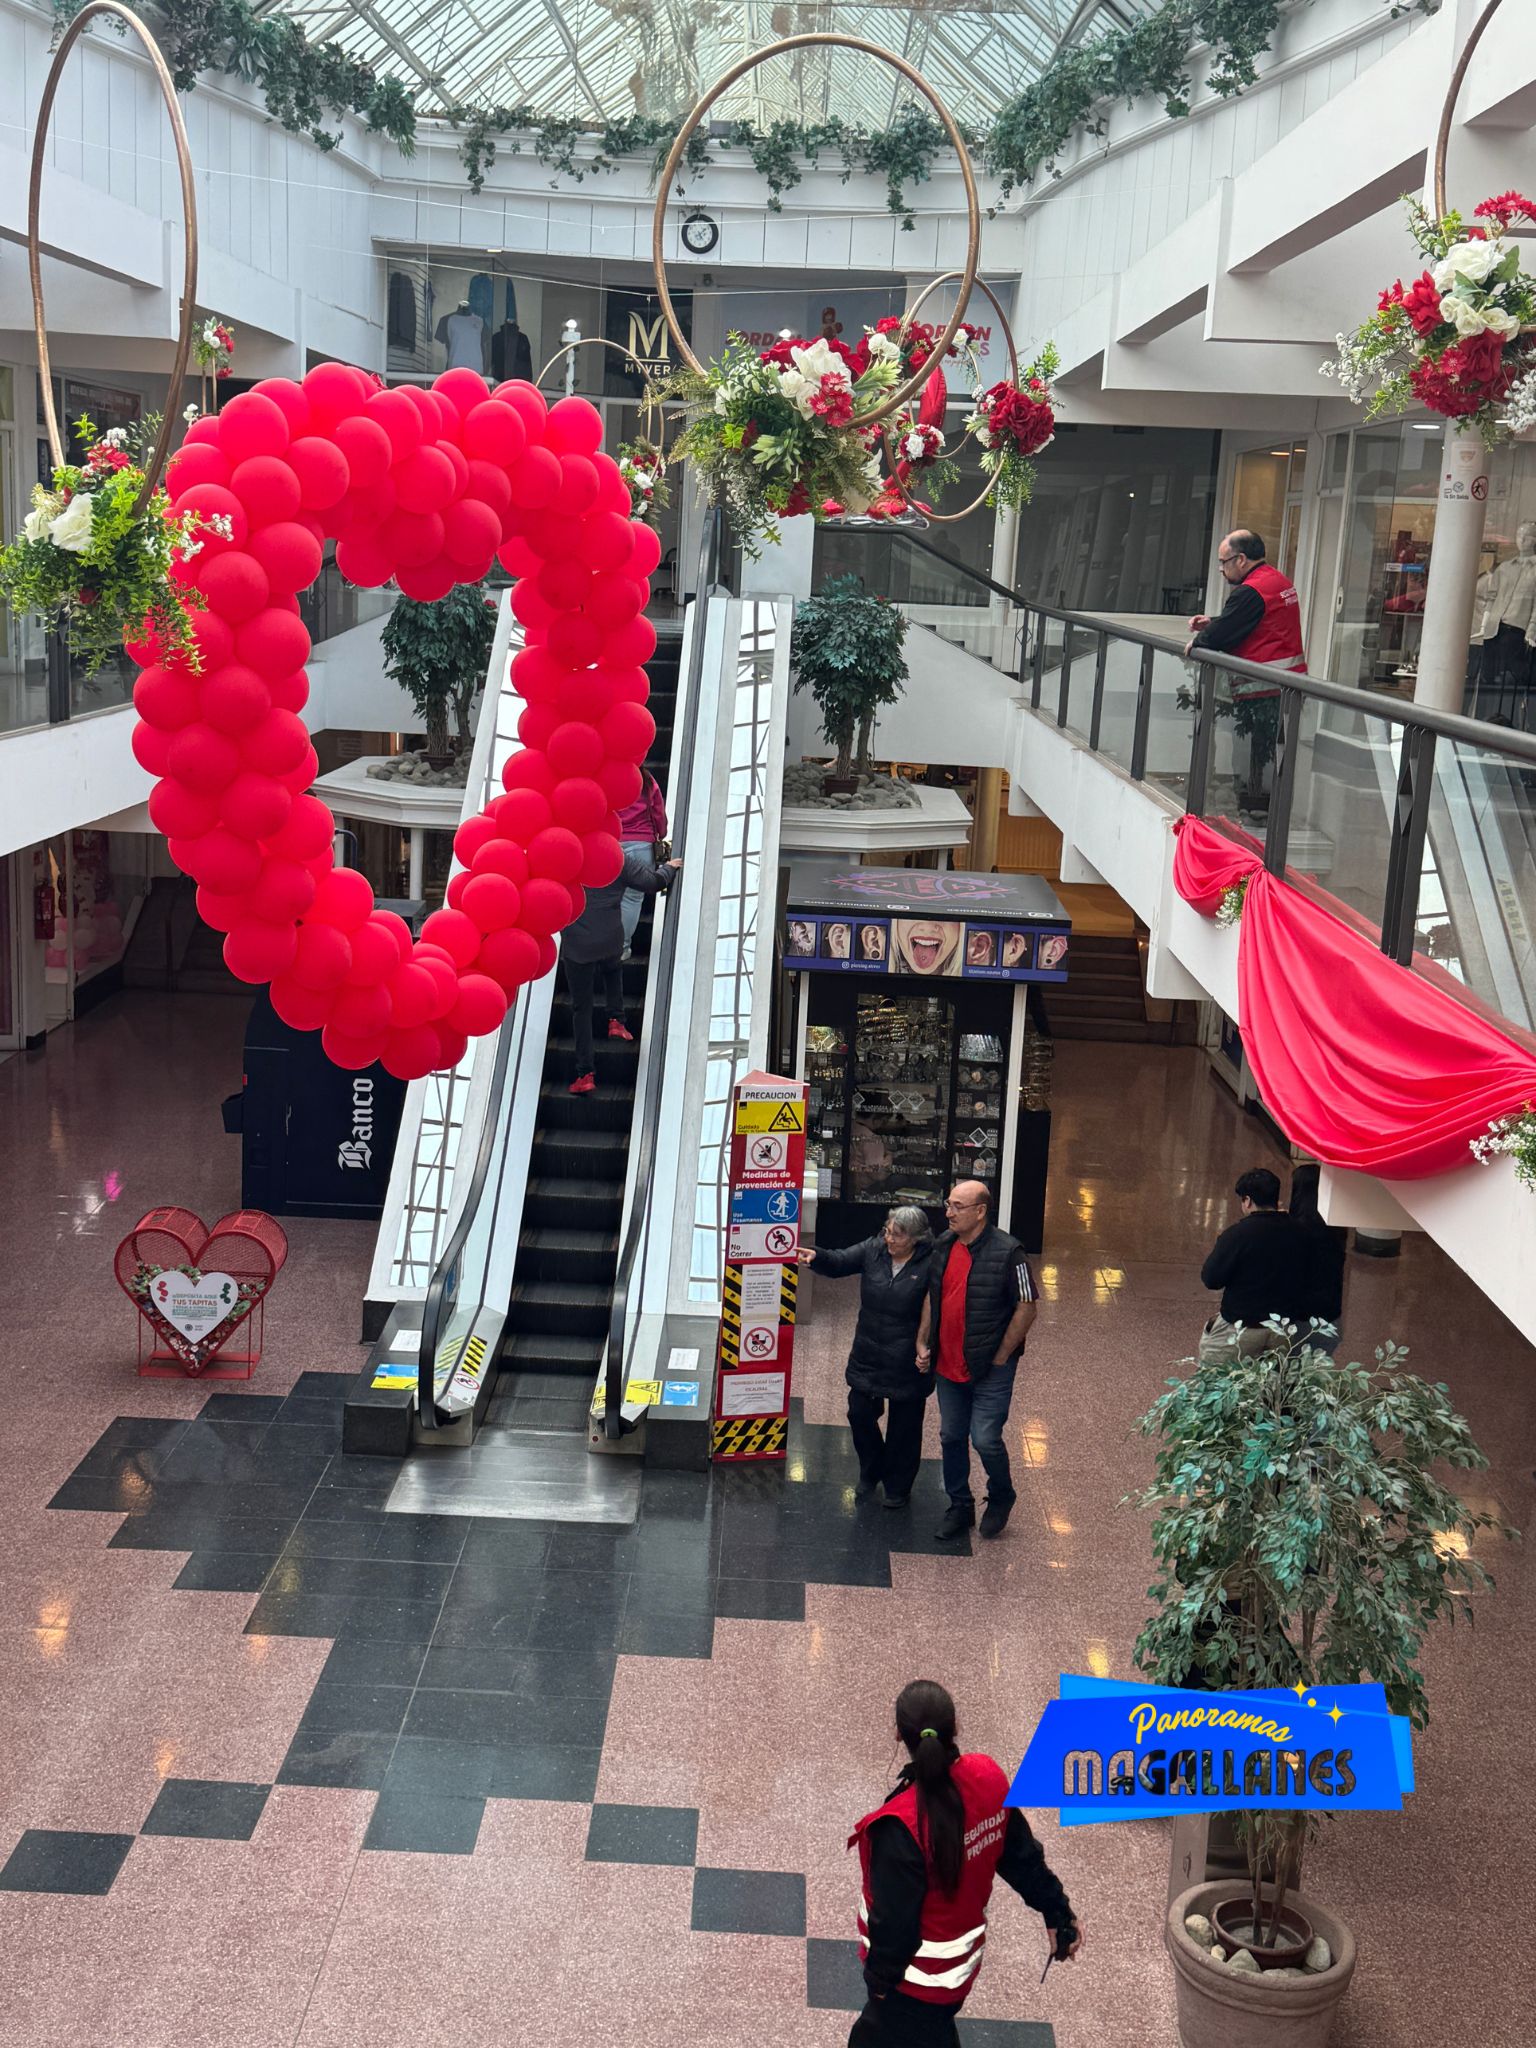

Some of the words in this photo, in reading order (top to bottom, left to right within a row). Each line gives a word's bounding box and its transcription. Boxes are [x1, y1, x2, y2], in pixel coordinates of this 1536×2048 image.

[745, 1091, 797, 1099] PRECAUCION
[338, 1078, 374, 1171] Banco
[742, 1171, 777, 1179] Medidas
[779, 1170, 791, 1178] de
[735, 1181, 783, 1190] prevención
[785, 1180, 796, 1188] de
[963, 1808, 1006, 1846] EGURIDAD
